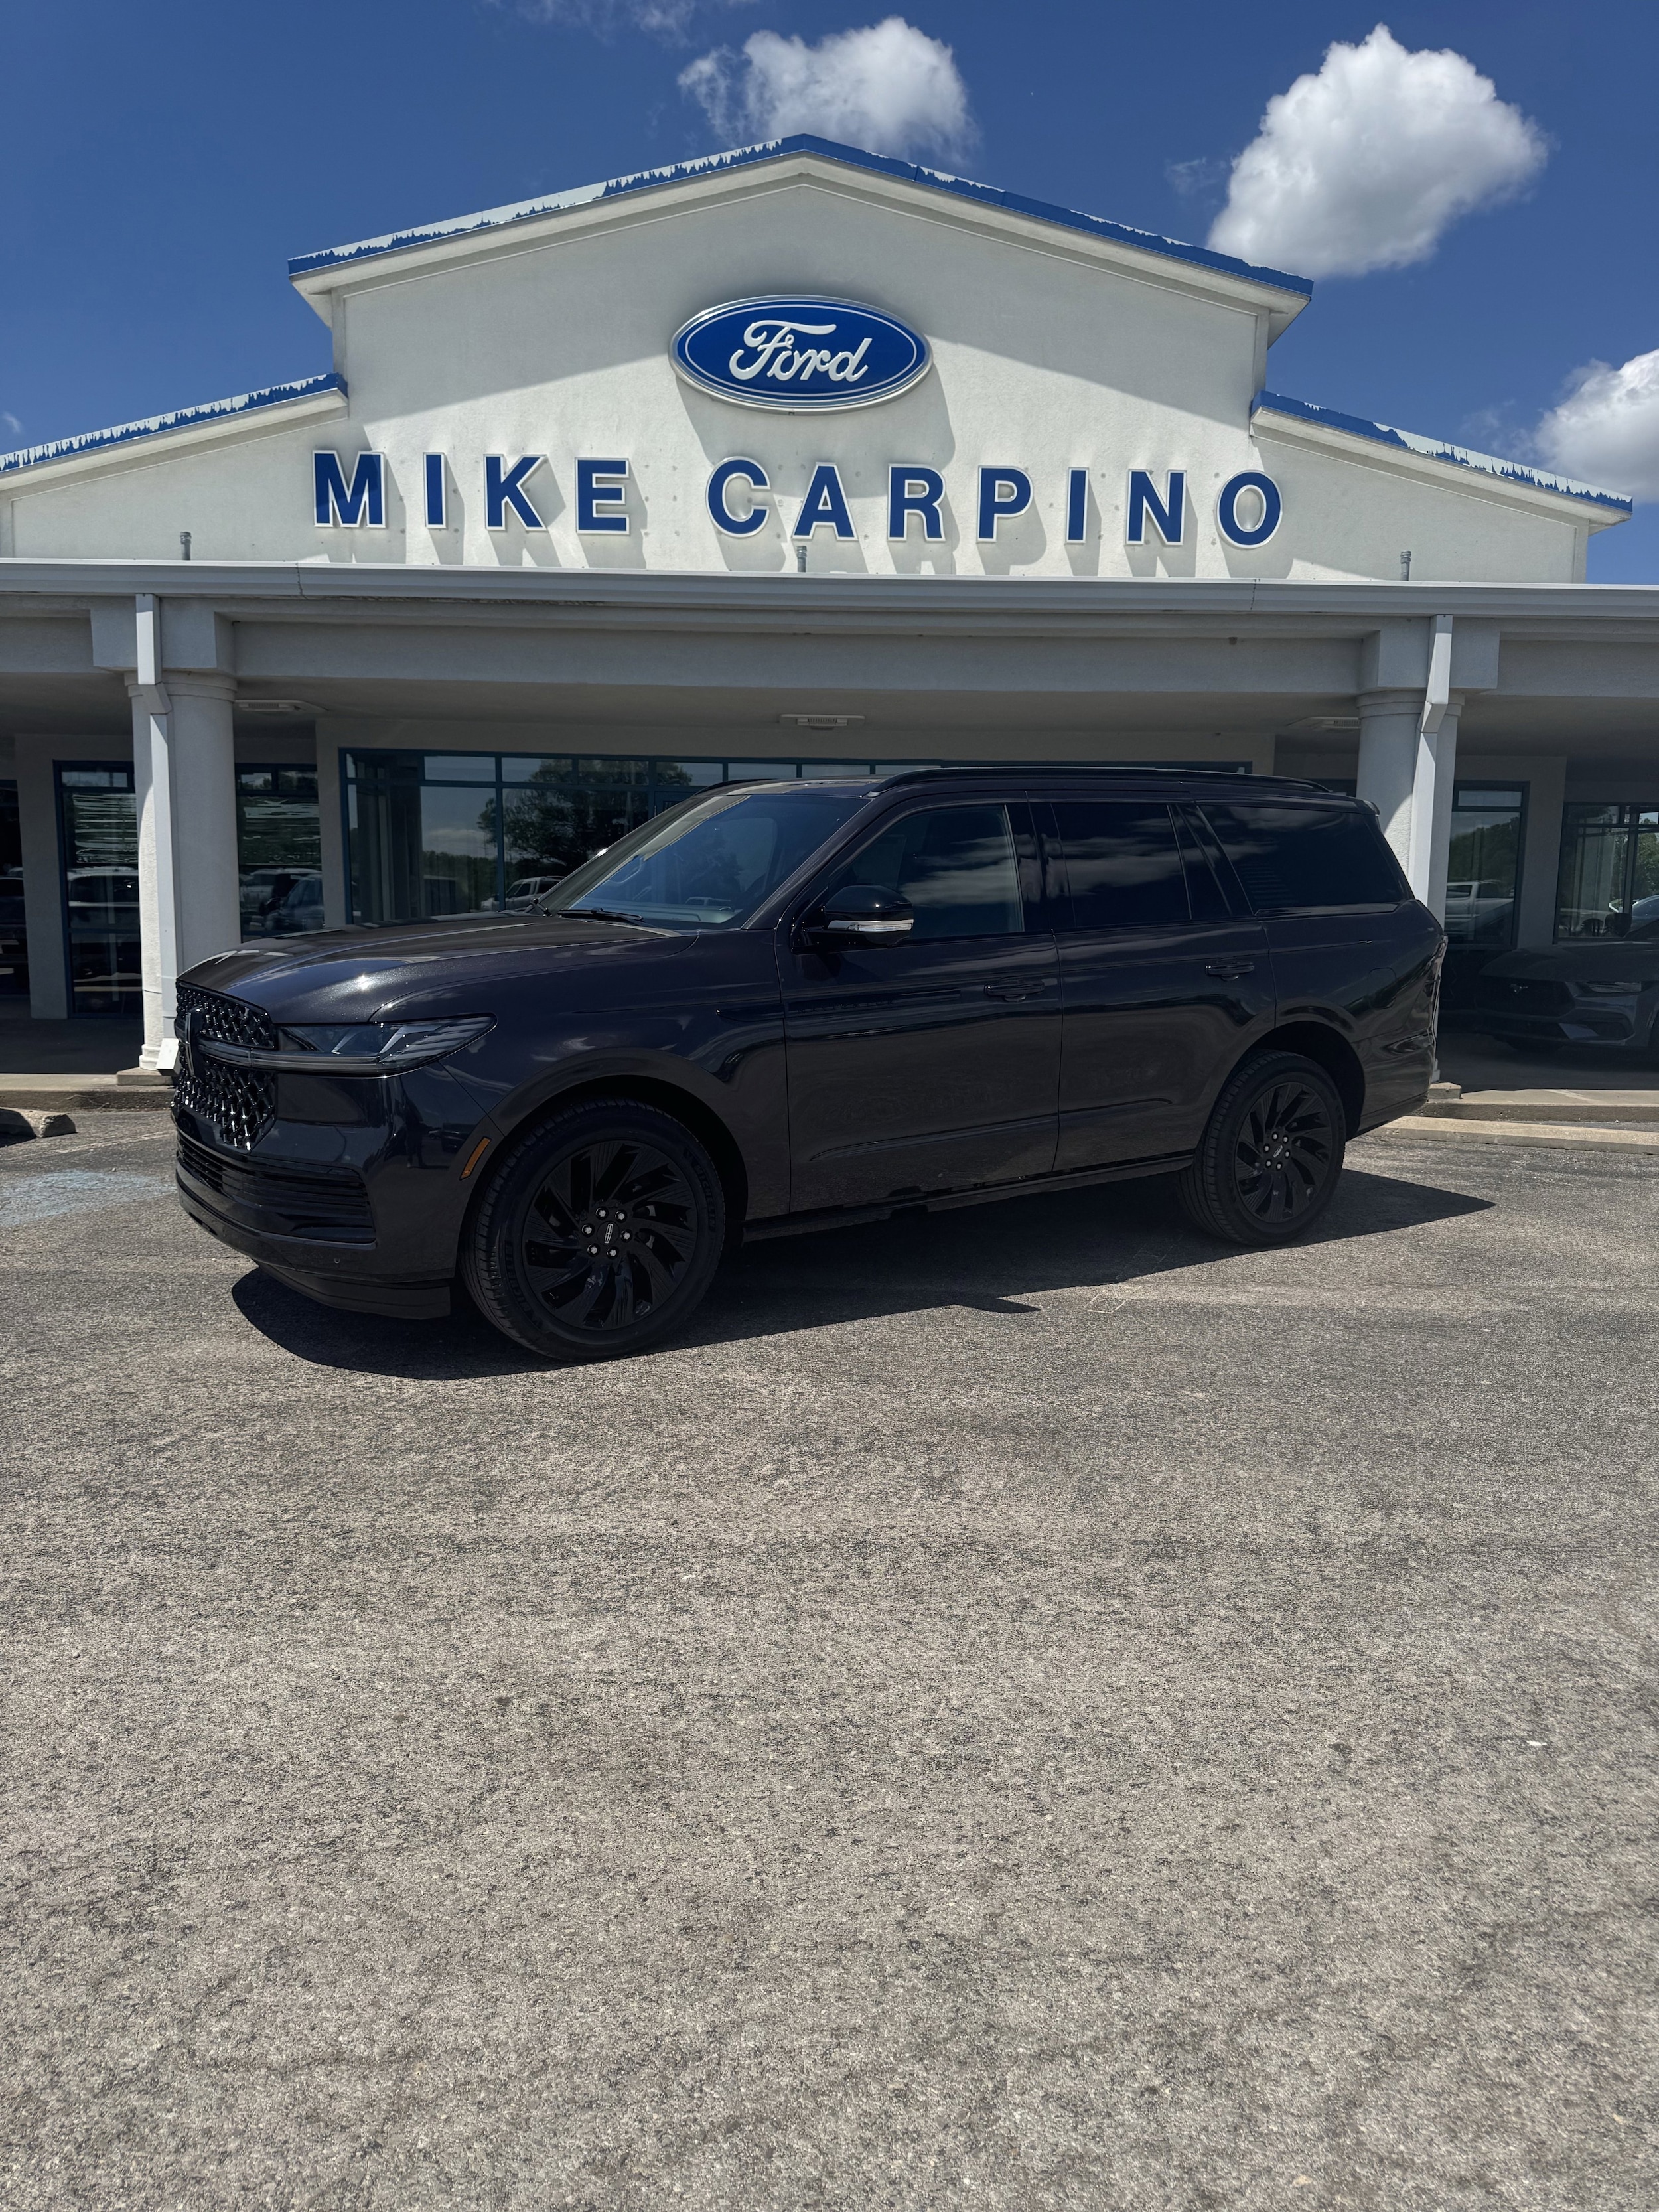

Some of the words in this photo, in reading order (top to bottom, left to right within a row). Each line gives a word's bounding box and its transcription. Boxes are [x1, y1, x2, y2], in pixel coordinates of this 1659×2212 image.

[728, 319, 872, 382] Ford
[312, 449, 631, 535] MIKE
[705, 455, 1283, 549] CARPINO
